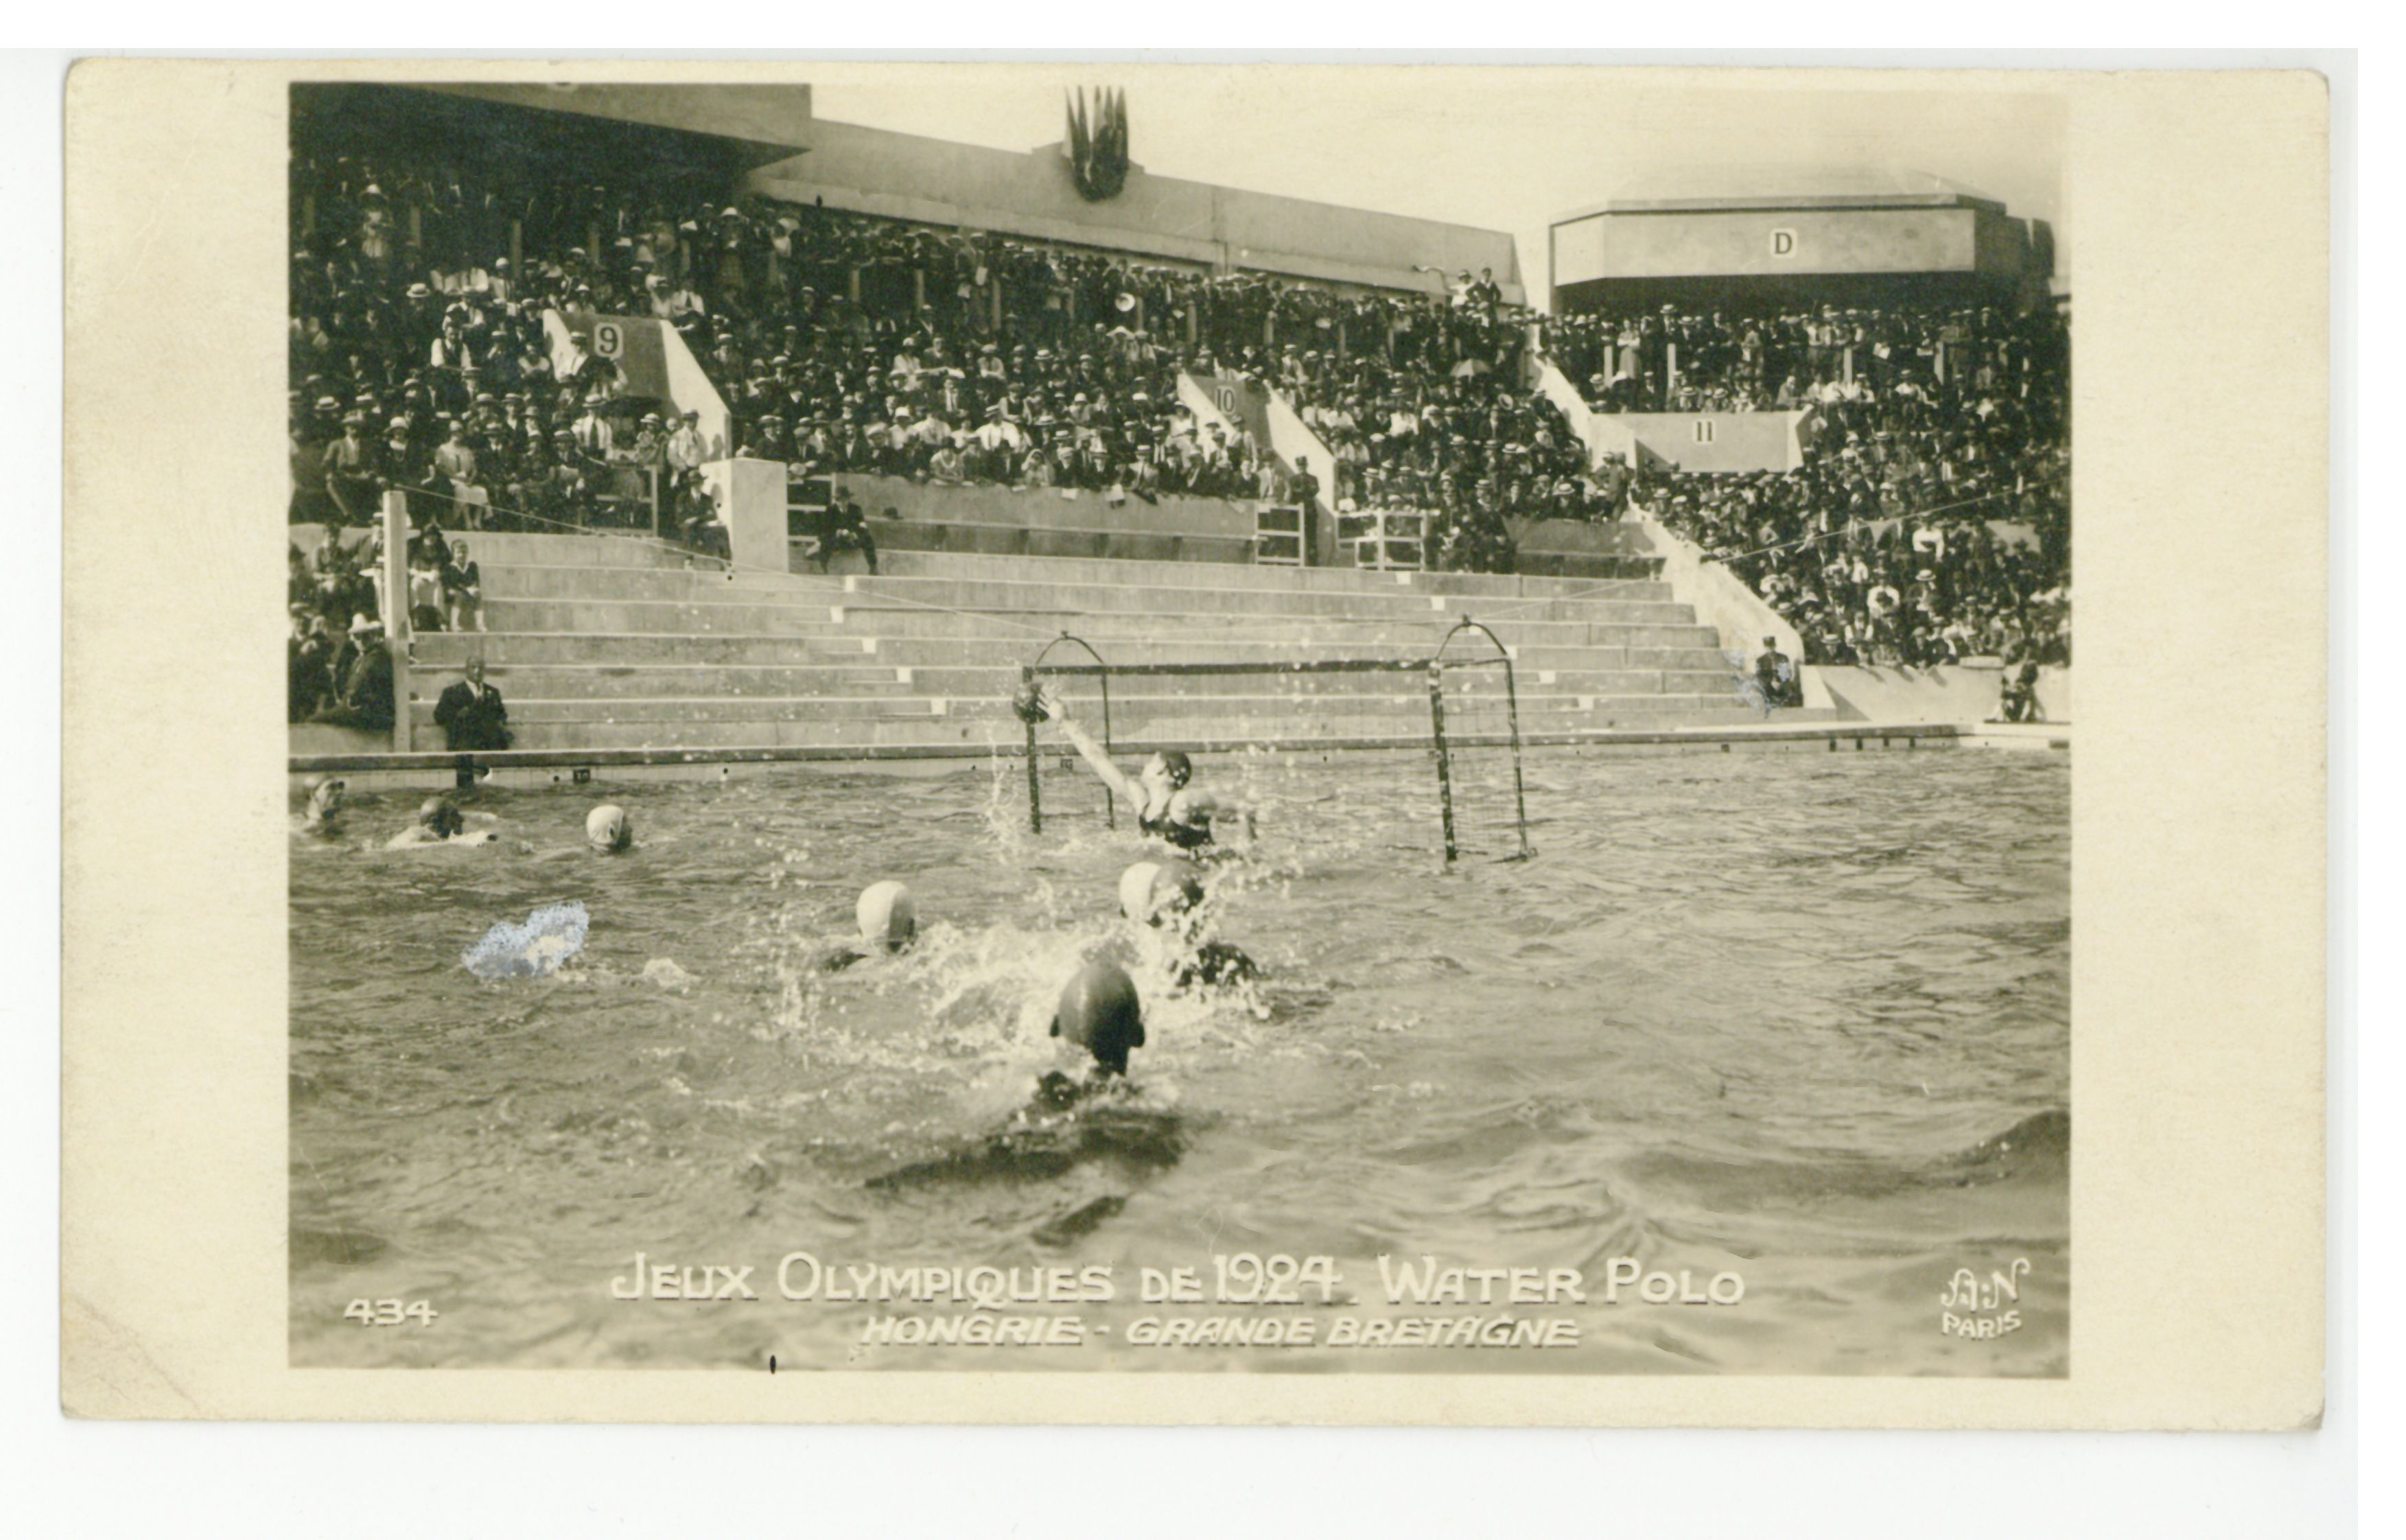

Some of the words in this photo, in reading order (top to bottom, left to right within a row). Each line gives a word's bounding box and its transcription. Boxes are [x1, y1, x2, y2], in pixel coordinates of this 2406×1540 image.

[1775, 232, 1792, 255] D
[598, 325, 618, 354] 9
[1217, 388, 1235, 412] 10
[1696, 420, 1713, 442] 11
